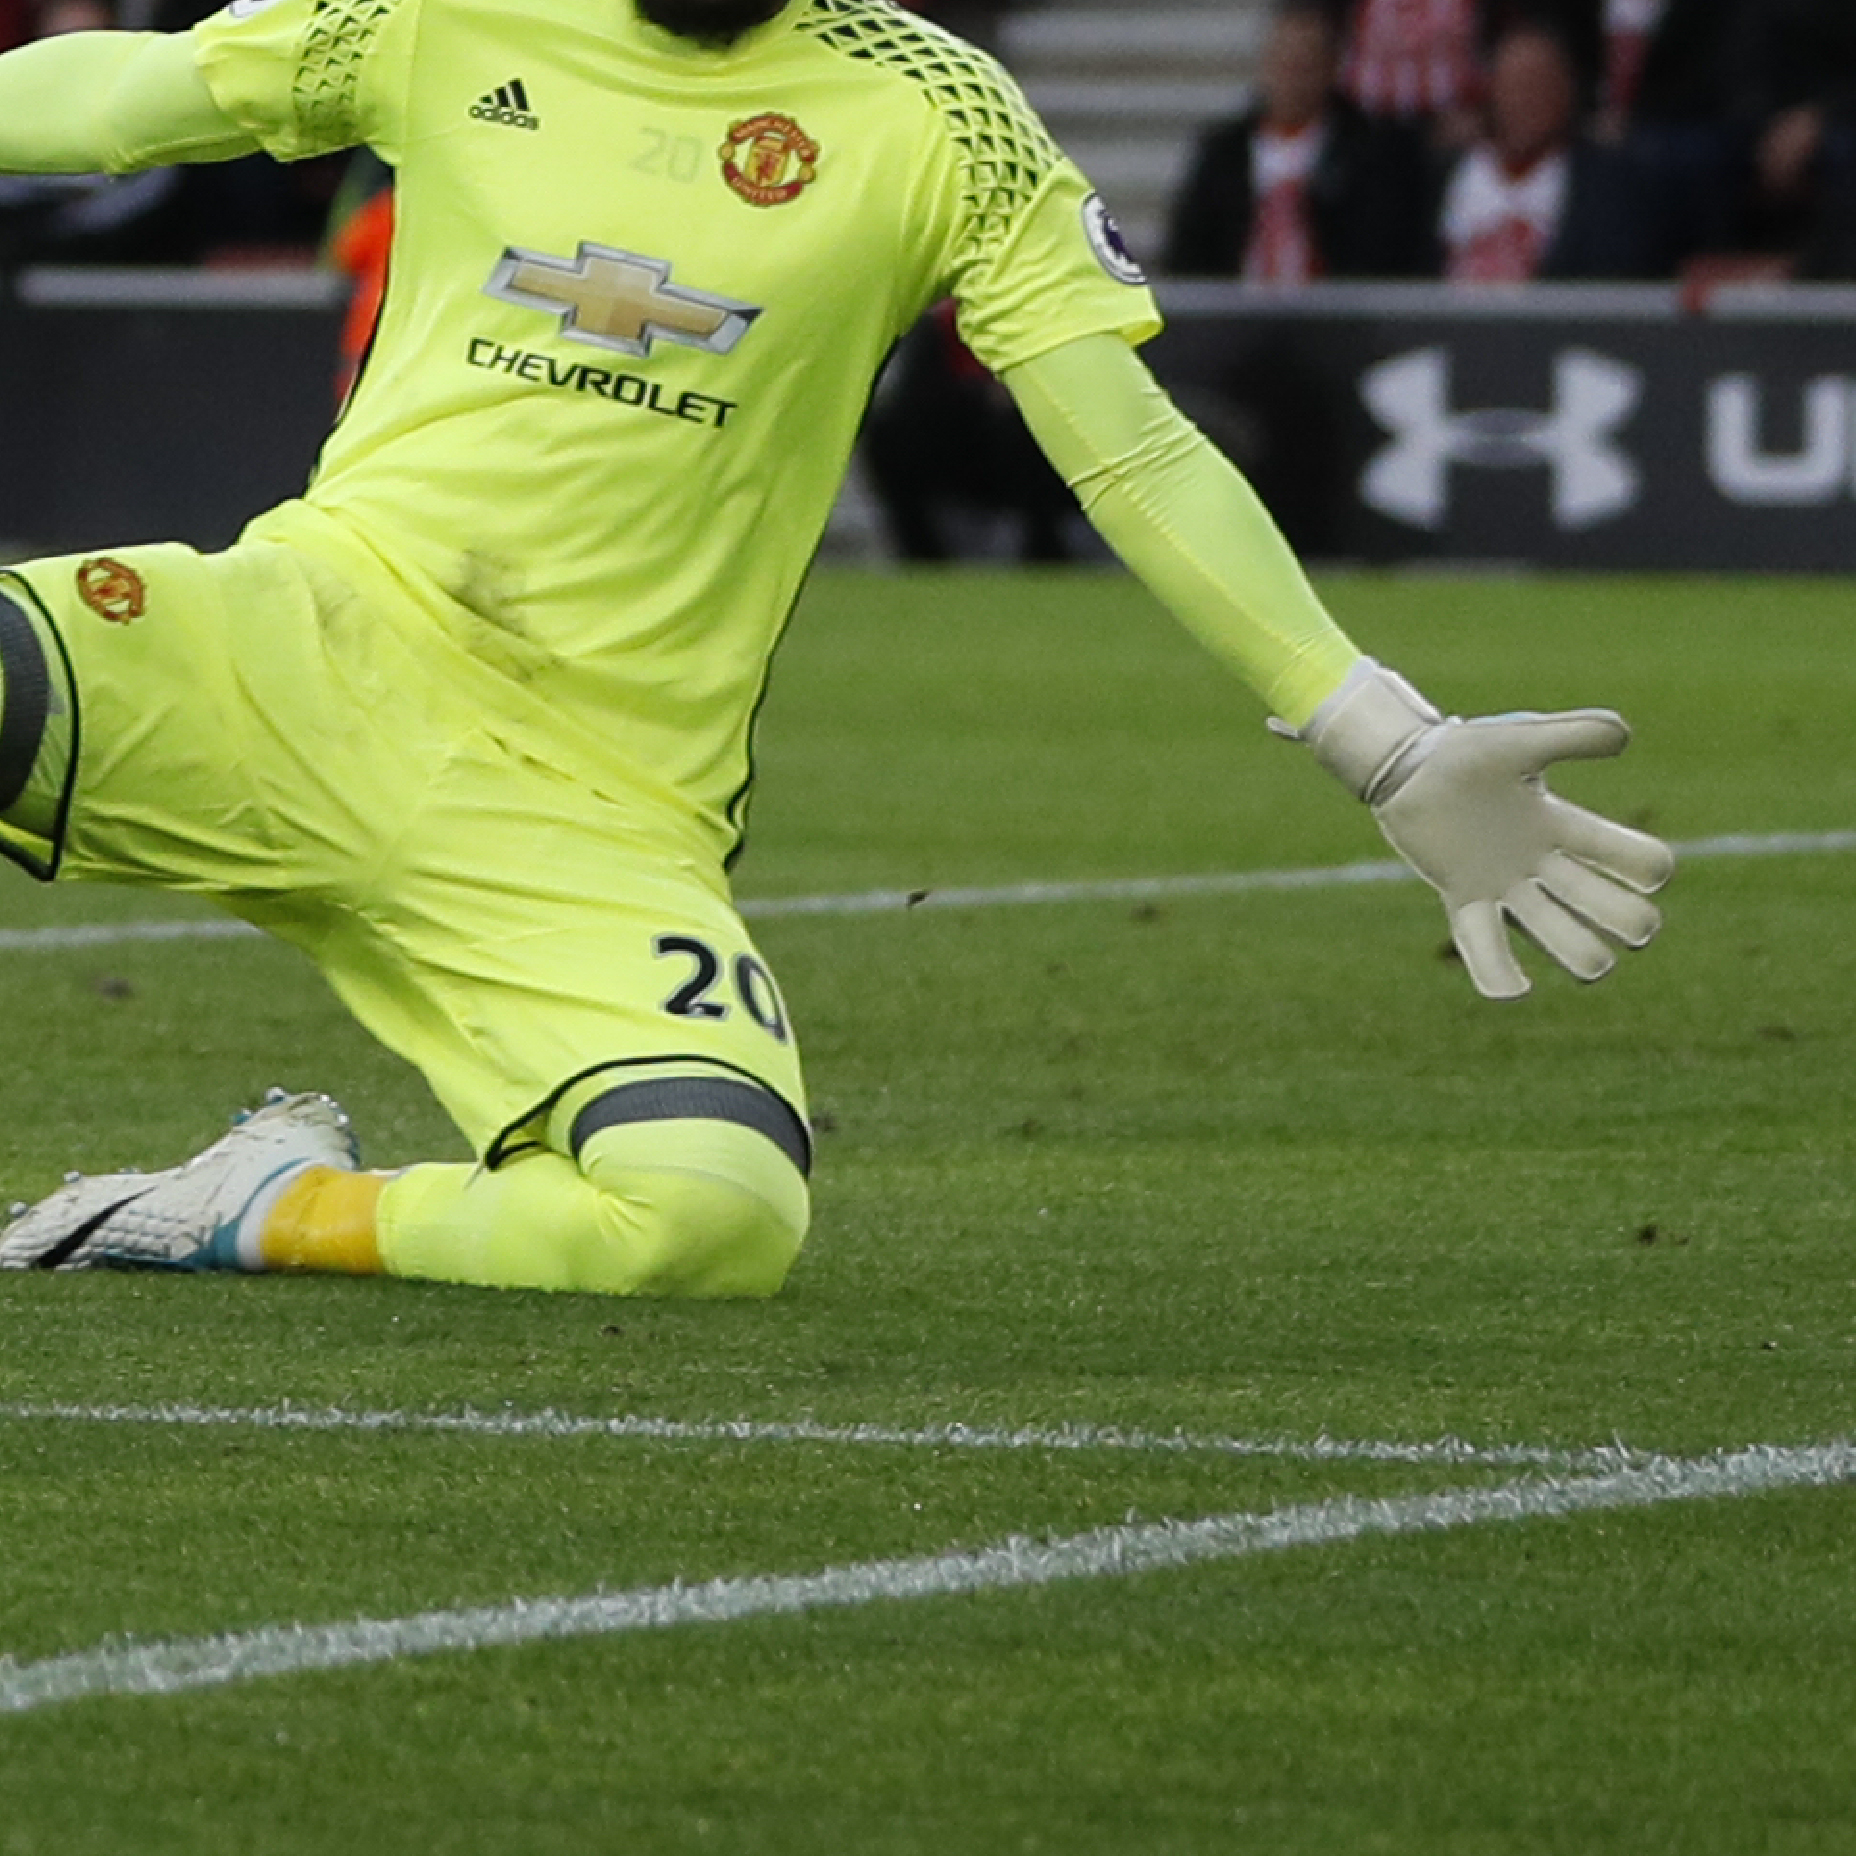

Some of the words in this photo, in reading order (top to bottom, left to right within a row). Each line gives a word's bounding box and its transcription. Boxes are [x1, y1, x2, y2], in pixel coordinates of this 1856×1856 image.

[468, 105, 540, 131] adidas
[630, 126, 705, 184] 20
[466, 335, 738, 429] CHEVROLET
[653, 934, 787, 1042] 20
